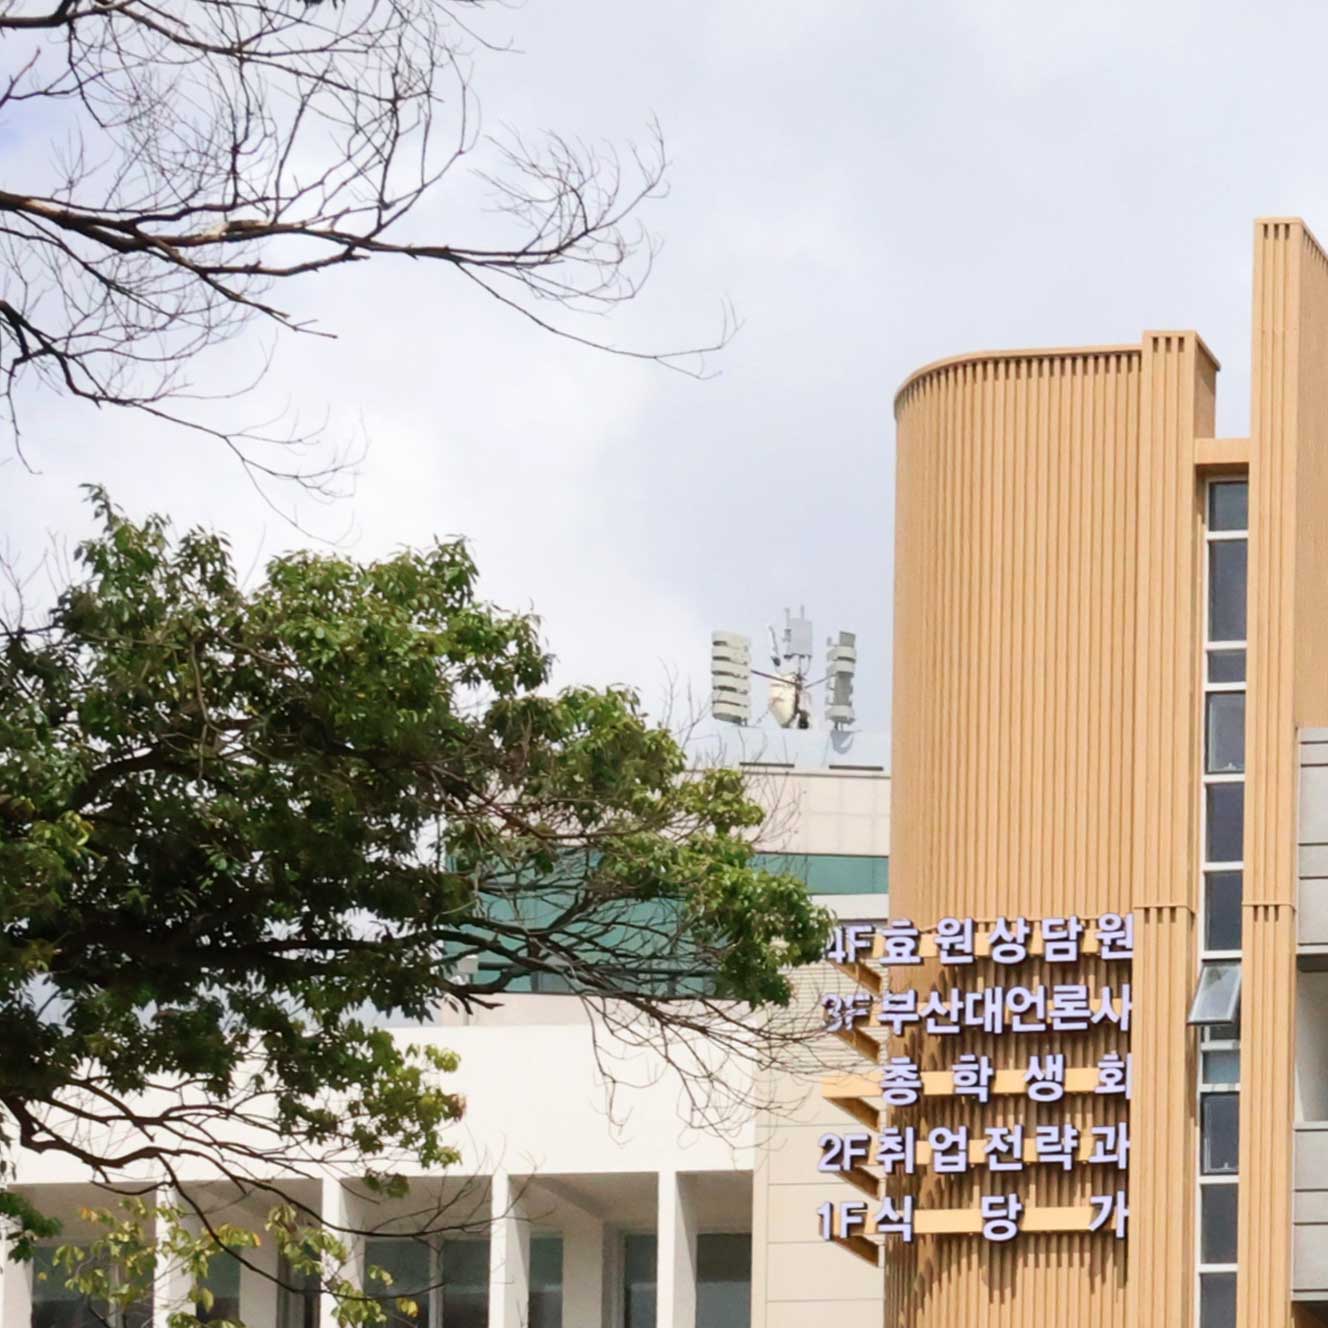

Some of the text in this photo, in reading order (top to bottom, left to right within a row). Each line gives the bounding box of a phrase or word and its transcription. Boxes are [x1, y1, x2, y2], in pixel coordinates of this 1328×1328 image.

[827, 913, 1134, 966] 4F 효원상담원
[821, 984, 1132, 1034] 3F 부산대언론사
[818, 1122, 1130, 1173] 2F 취업전략과
[817, 1201, 867, 1241] 1F
